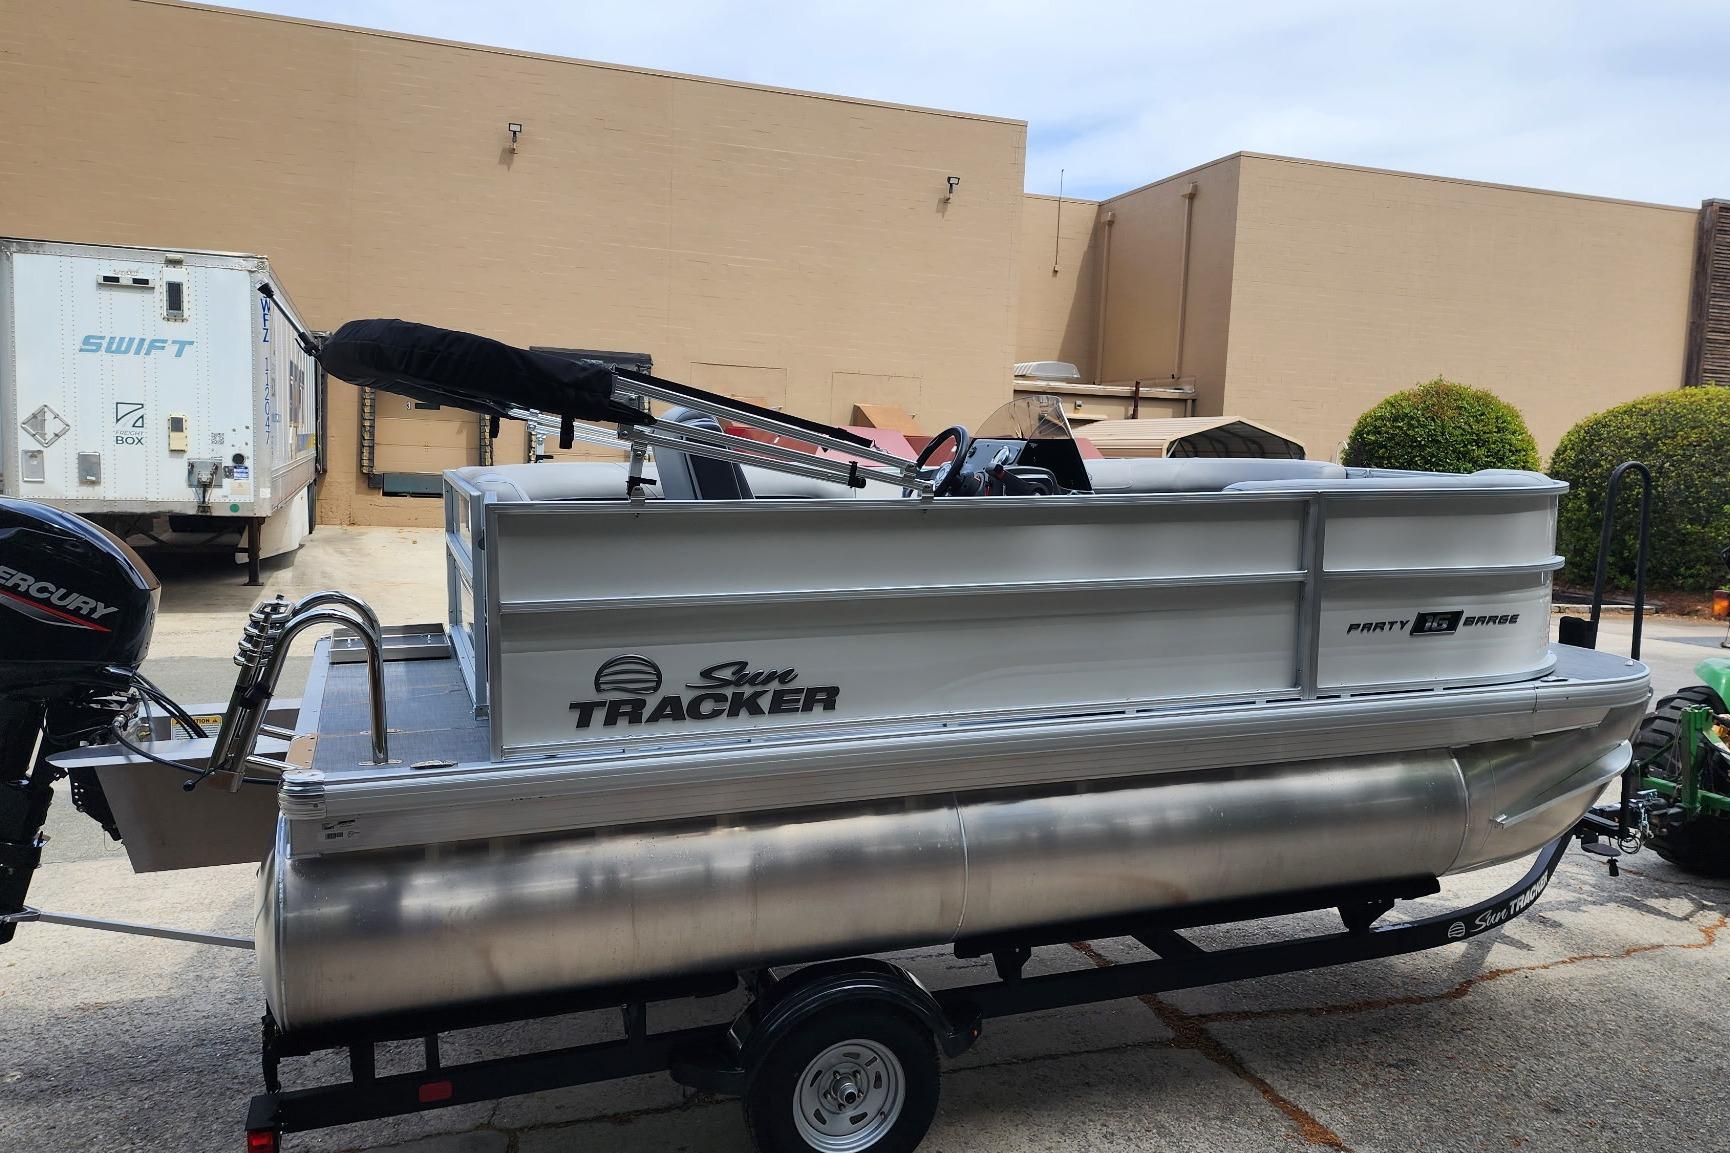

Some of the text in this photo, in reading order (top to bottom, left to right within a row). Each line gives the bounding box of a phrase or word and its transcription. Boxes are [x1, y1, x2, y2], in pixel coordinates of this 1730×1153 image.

[79, 335, 194, 358] SWIFT
[260, 294, 271, 445] WFZ 112047
[115, 435, 144, 445] BOX
[1347, 614, 1520, 635] PARTY 16 BARGE
[685, 660, 798, 689] Sun
[569, 685, 840, 729] TRACKER
[1470, 909, 1509, 932] Sun
